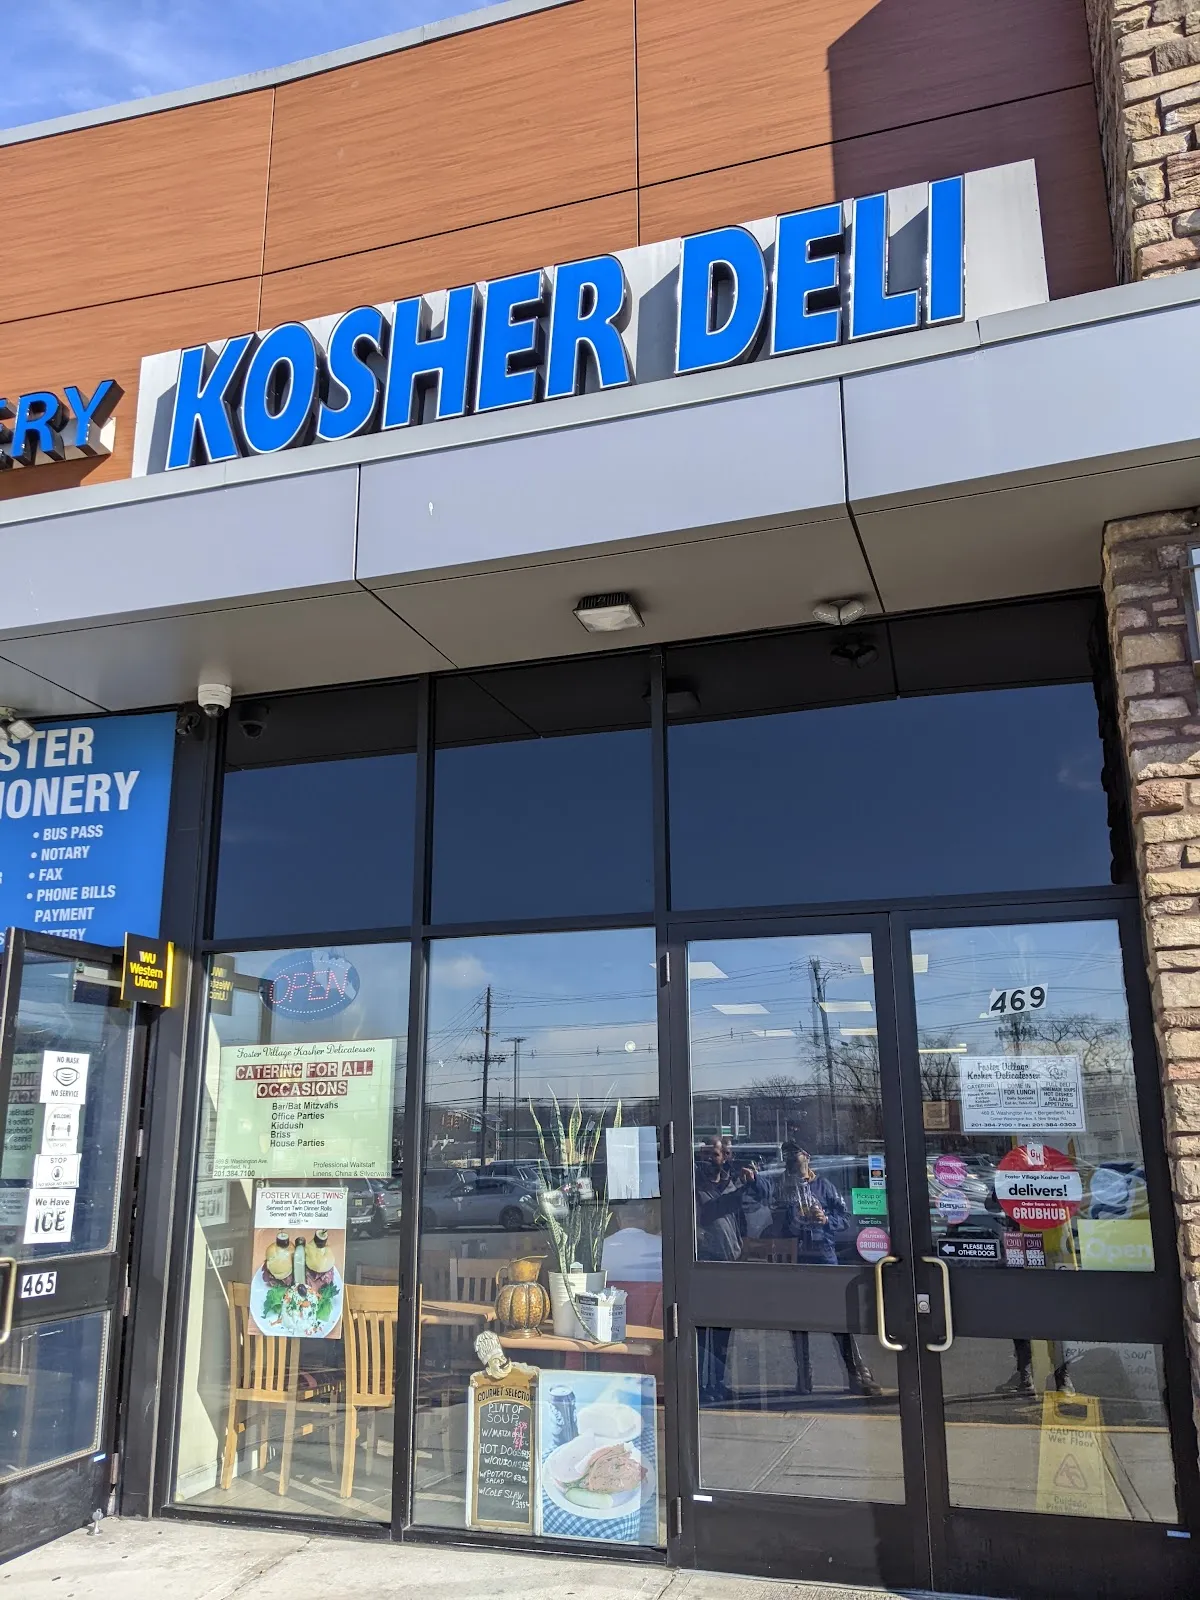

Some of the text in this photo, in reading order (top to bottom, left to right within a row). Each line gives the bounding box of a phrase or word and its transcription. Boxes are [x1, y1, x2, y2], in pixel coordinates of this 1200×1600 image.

[165, 173, 965, 471] KOSHER DELI
[0, 379, 118, 460] RY
[0, 726, 95, 772] STER
[42, 824, 104, 841] BUS PASS
[41, 845, 90, 861] NOTARY
[39, 868, 63, 881] FAX
[36, 884, 116, 902] PHONE BILLS
[34, 906, 95, 922] PAYMENT
[139, 950, 157, 965] WU
[129, 962, 163, 979] Western
[134, 975, 158, 989] Union
[269, 968, 348, 1004] OPEN
[990, 985, 1046, 1014] 469
[237, 1047, 261, 1059] Foster
[262, 1046, 292, 1059] Village
[327, 1044, 376, 1054] Delicatessen
[65, 1056, 80, 1064] MASK
[236, 1060, 373, 1080] CATERING FOR ALL
[51, 1089, 79, 1098] NO SERVICE
[257, 1080, 348, 1098] OCCASIONS
[272, 1101, 339, 1111] Bar/Bat Mitzvahs
[271, 1112, 325, 1120] Office Parties
[271, 1121, 304, 1130] Kiddush
[270, 1130, 291, 1139] Briss
[270, 1139, 325, 1148] House Parties
[260, 1191, 290, 1199] FOSTER
[1008, 1183, 1068, 1197] delivers!
[35, 1197, 70, 1206] We Have
[857, 1199, 882, 1207] delivery?
[1012, 1206, 1066, 1221] GRUBHUB
[34, 1210, 66, 1233] ICE
[859, 1241, 888, 1249] GRUBHUB
[1085, 1236, 1151, 1264] Open
[1007, 1257, 1025, 1266] 2020
[1027, 1258, 1045, 1266] 2021
[23, 1273, 55, 1296] 465
[478, 1386, 503, 1401] GOURMET
[488, 1403, 524, 1414] PINT OF
[487, 1413, 520, 1424] SOUP
[1049, 1428, 1092, 1439] CAUTION
[1048, 1434, 1095, 1448] Wet Floor
[480, 1443, 498, 1454] HOT
[504, 1489, 525, 1500] SLAW
